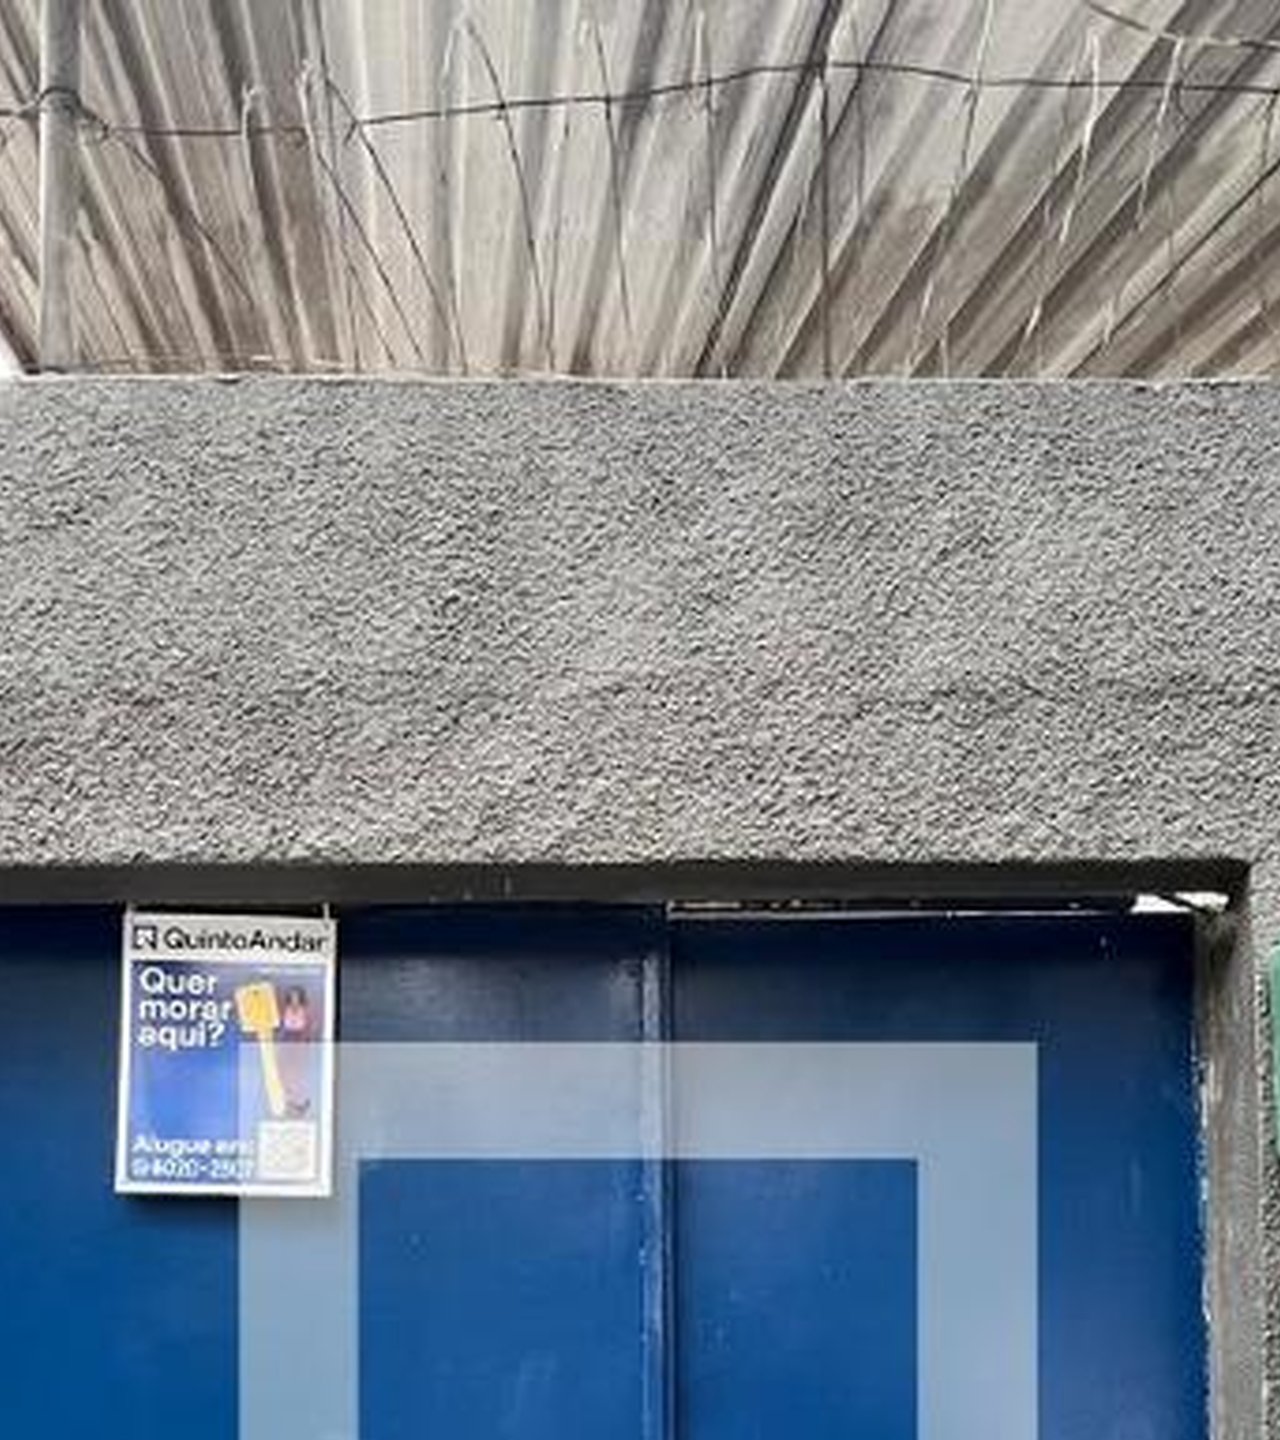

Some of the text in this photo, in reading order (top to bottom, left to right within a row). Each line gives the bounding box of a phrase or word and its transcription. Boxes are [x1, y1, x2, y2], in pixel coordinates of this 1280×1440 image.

[163, 926, 328, 951] QuintoAndar
[140, 967, 218, 995] Quer
[139, 1000, 232, 1021] morar
[138, 1023, 225, 1050] aqui?
